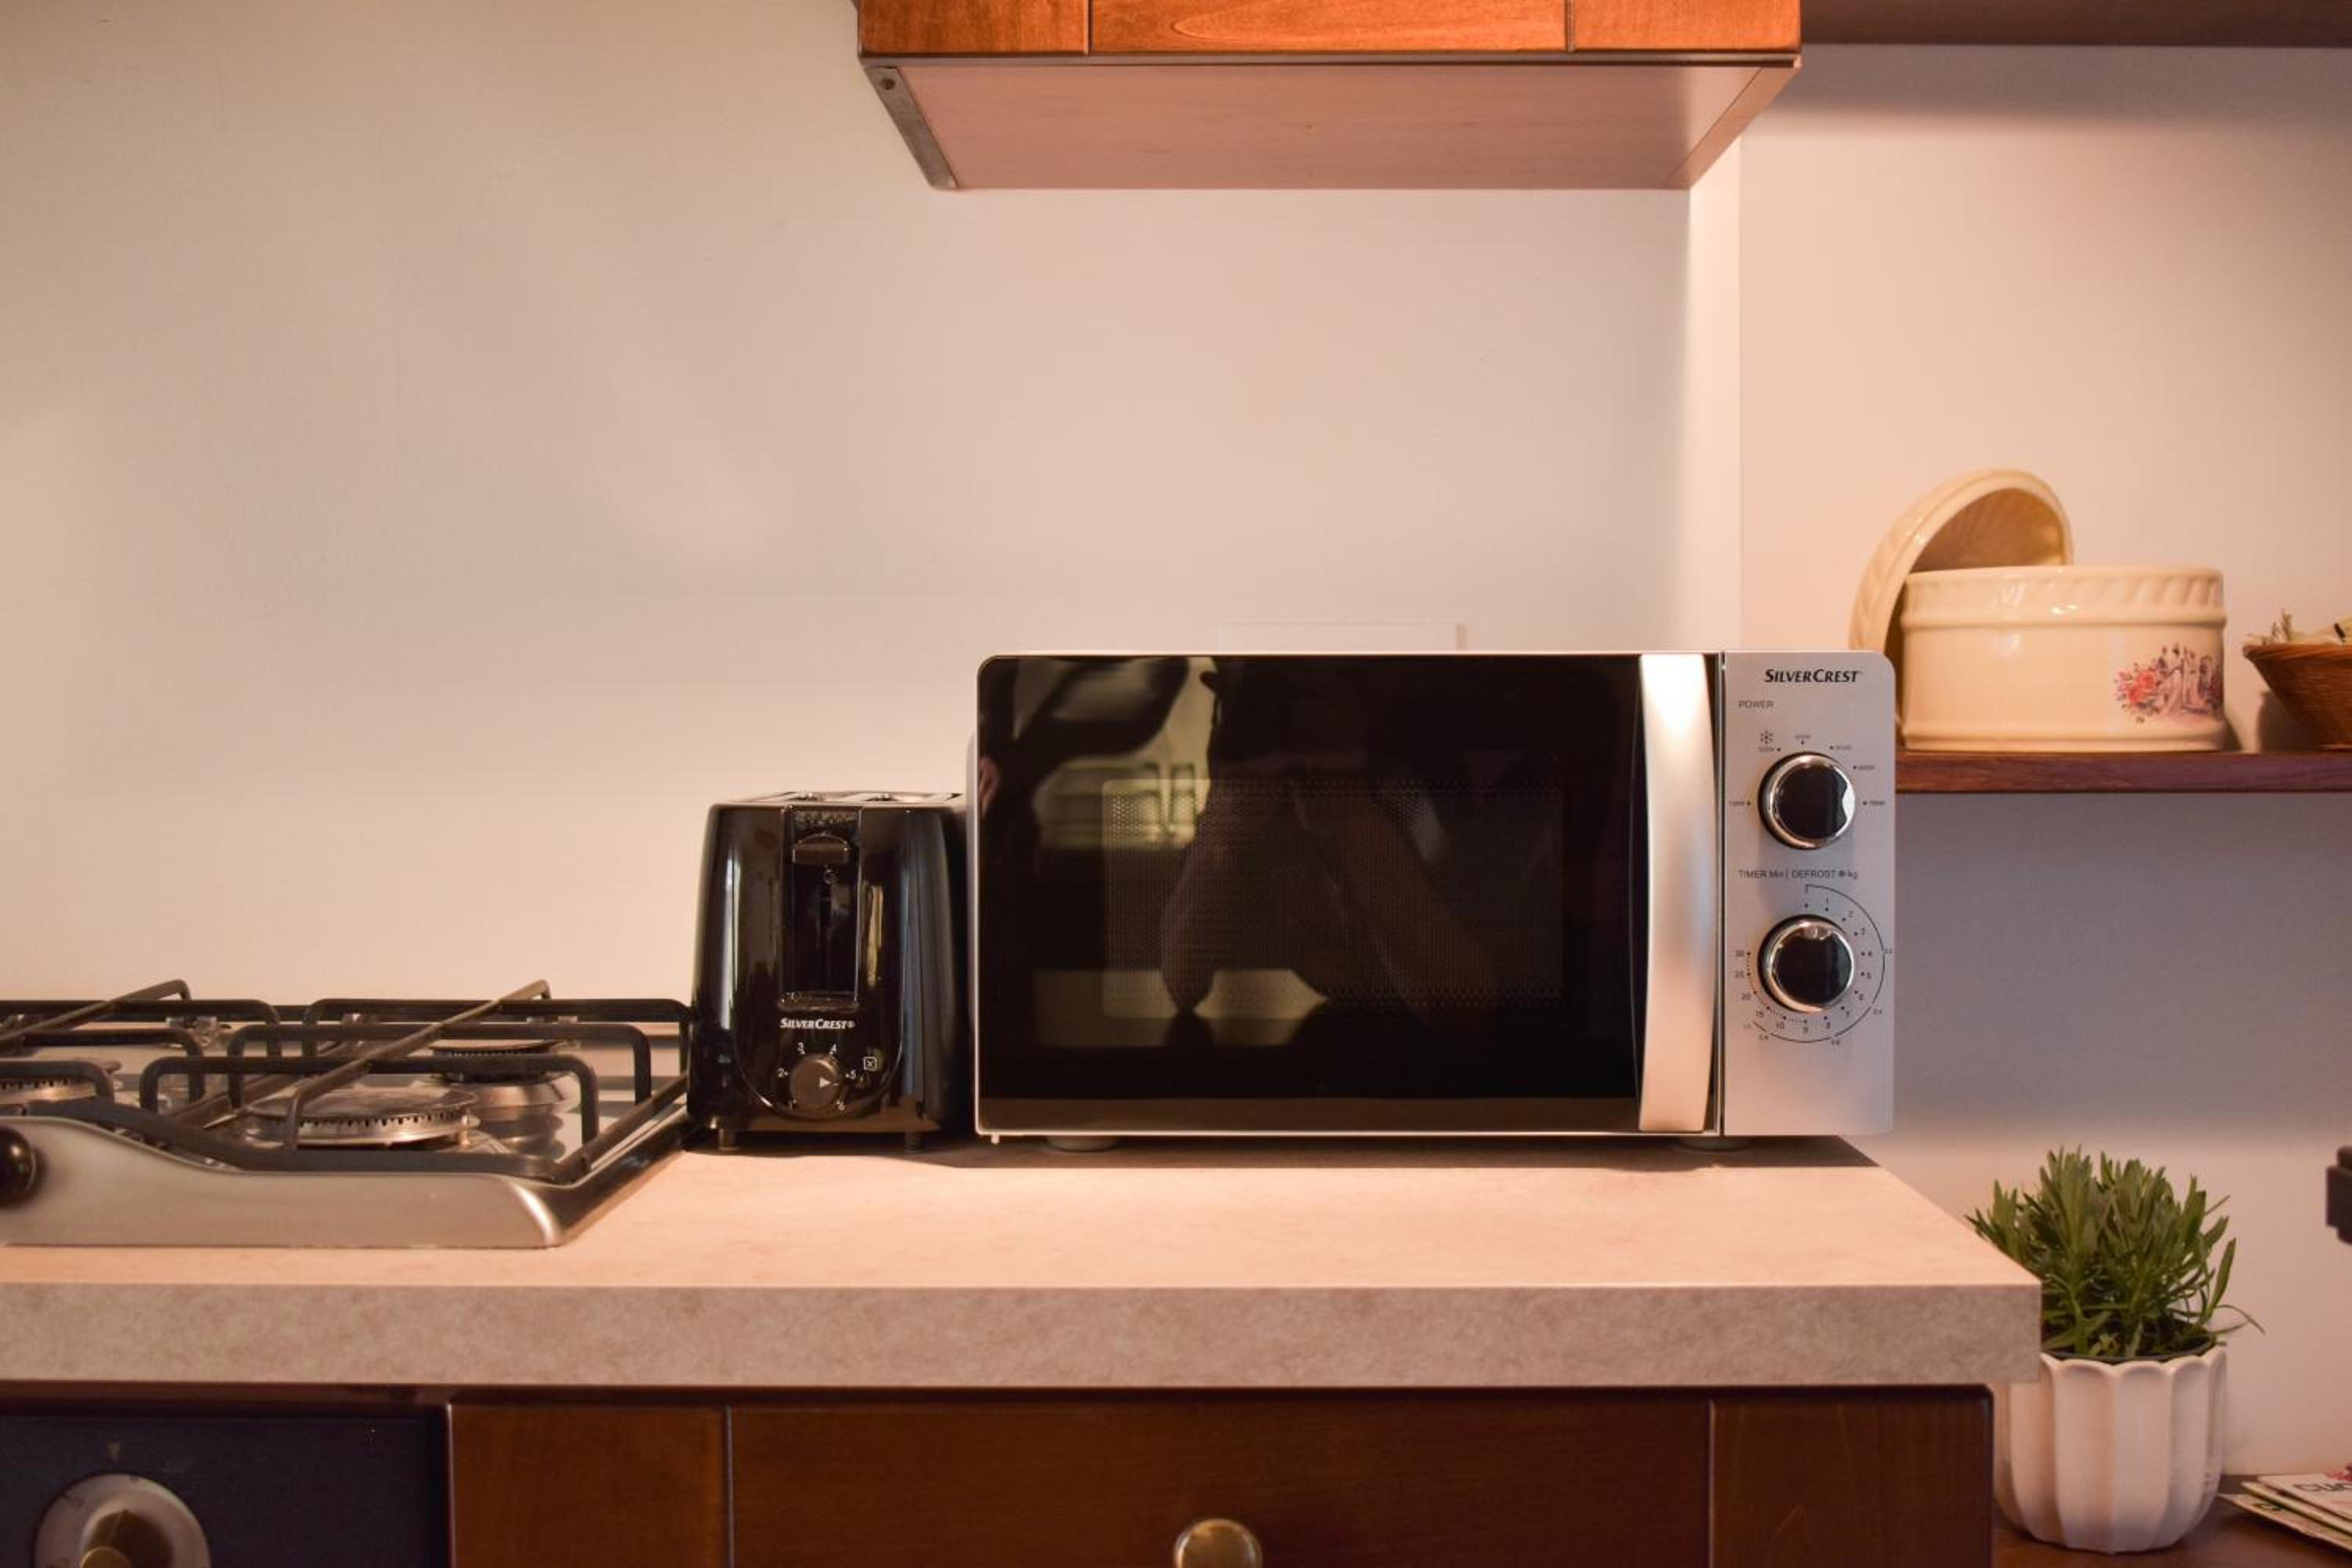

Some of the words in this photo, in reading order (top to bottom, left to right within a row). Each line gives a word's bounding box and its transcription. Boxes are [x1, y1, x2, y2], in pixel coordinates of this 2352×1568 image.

[1738, 700, 1774, 709] POWER
[1739, 869, 1767, 878] TIMER
[1791, 869, 1836, 879] DEFROST
[797, 1042, 804, 1051] 3
[830, 1044, 837, 1053] 4
[778, 1067, 785, 1078] 2
[849, 1069, 857, 1080] 5
